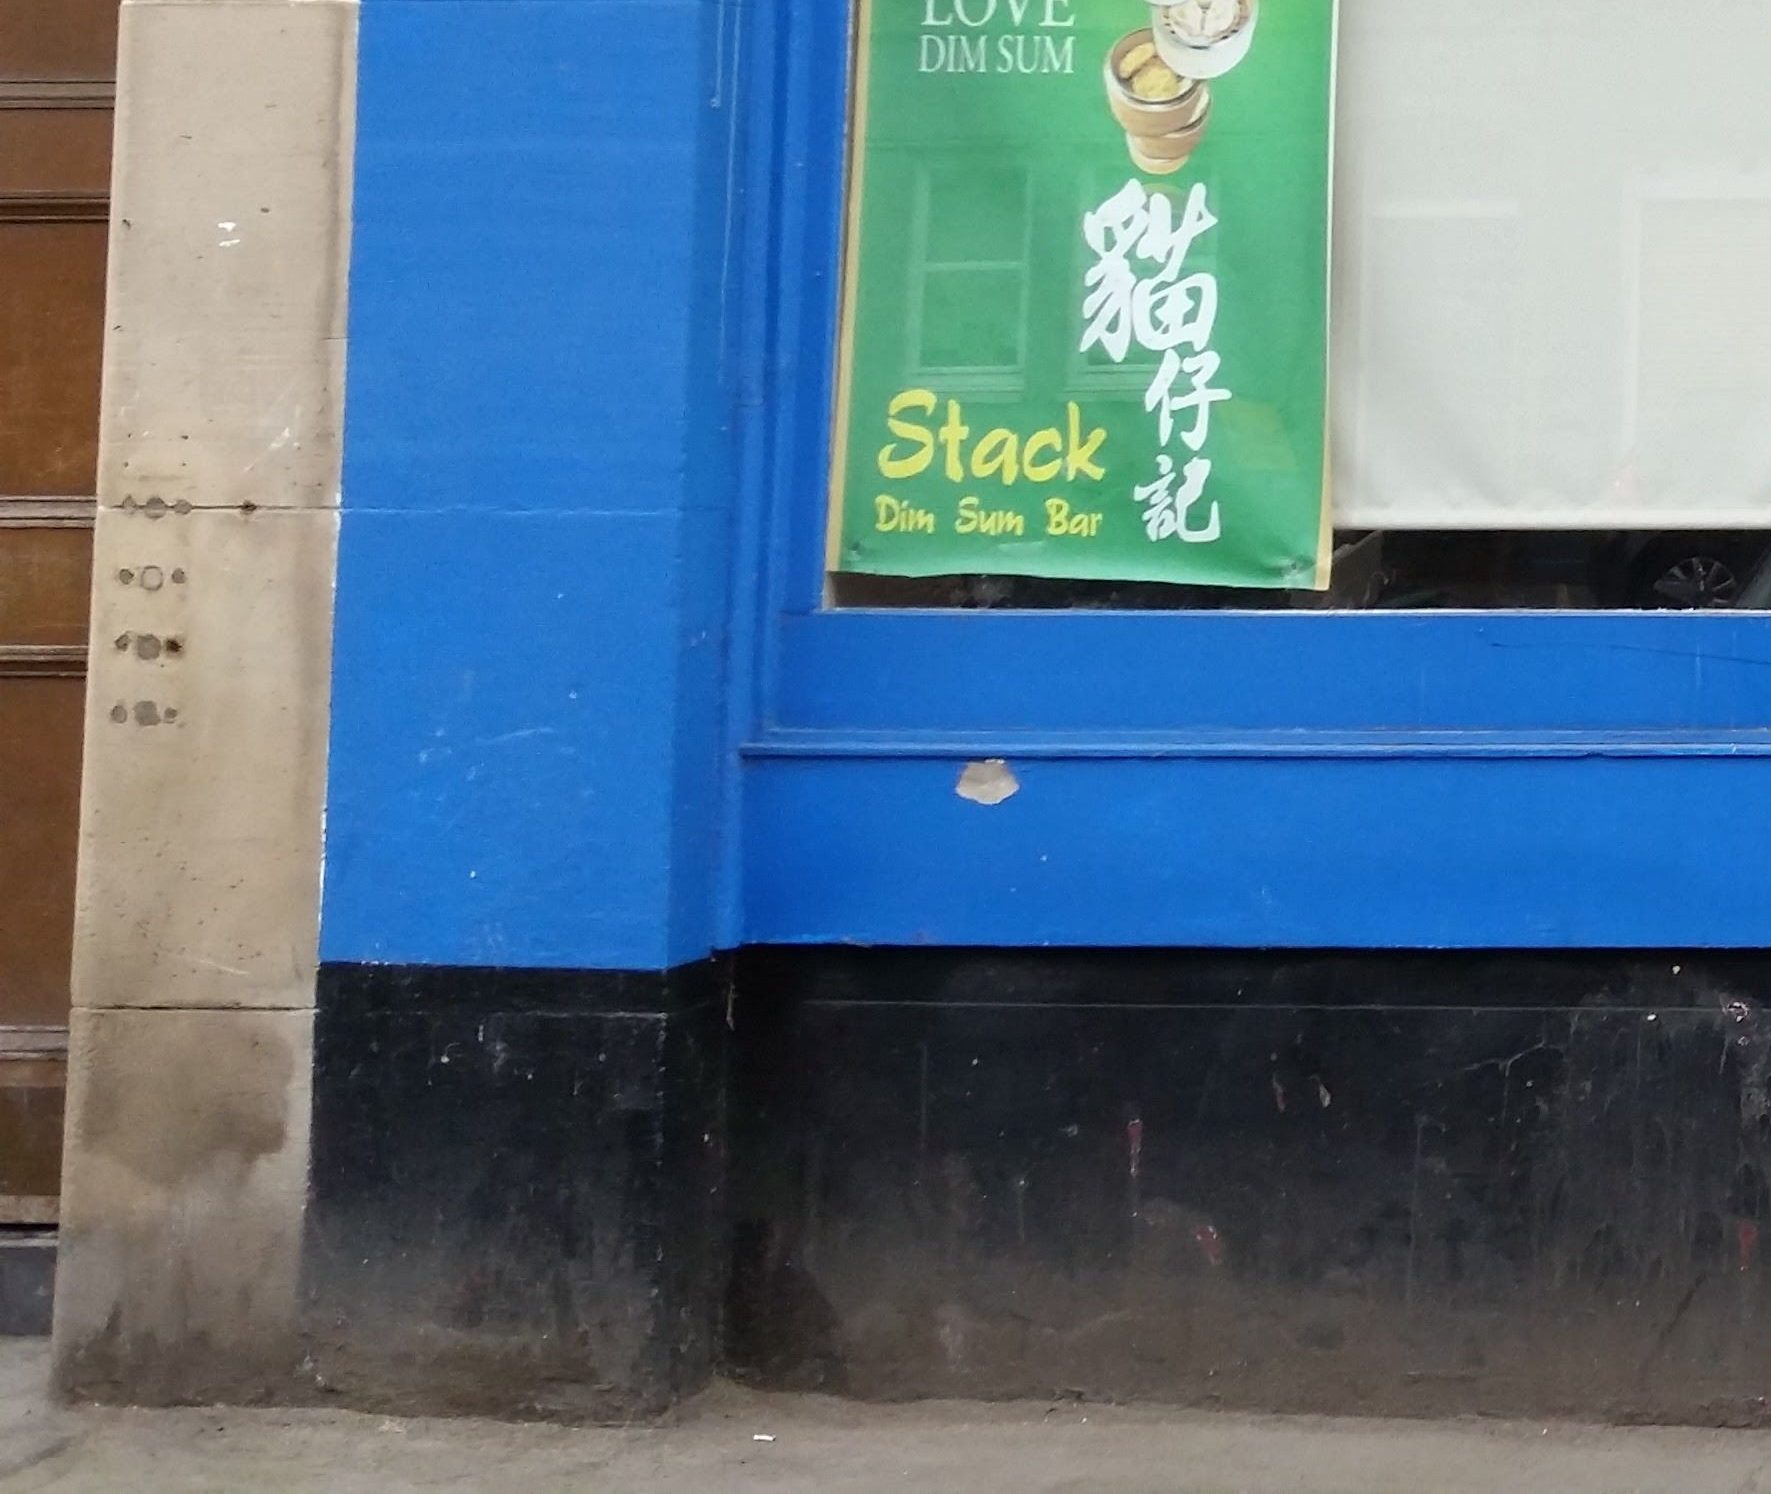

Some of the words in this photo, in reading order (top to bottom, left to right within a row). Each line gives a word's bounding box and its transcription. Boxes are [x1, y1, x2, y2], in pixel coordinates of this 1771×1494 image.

[918, 35, 987, 75] DIM
[996, 35, 1076, 74] SUM
[1078, 178, 1232, 544] 貓仔記
[876, 388, 1107, 486] Stack
[874, 494, 935, 534] Dim
[954, 495, 1024, 537] Sum
[1045, 495, 1103, 538] Bar
